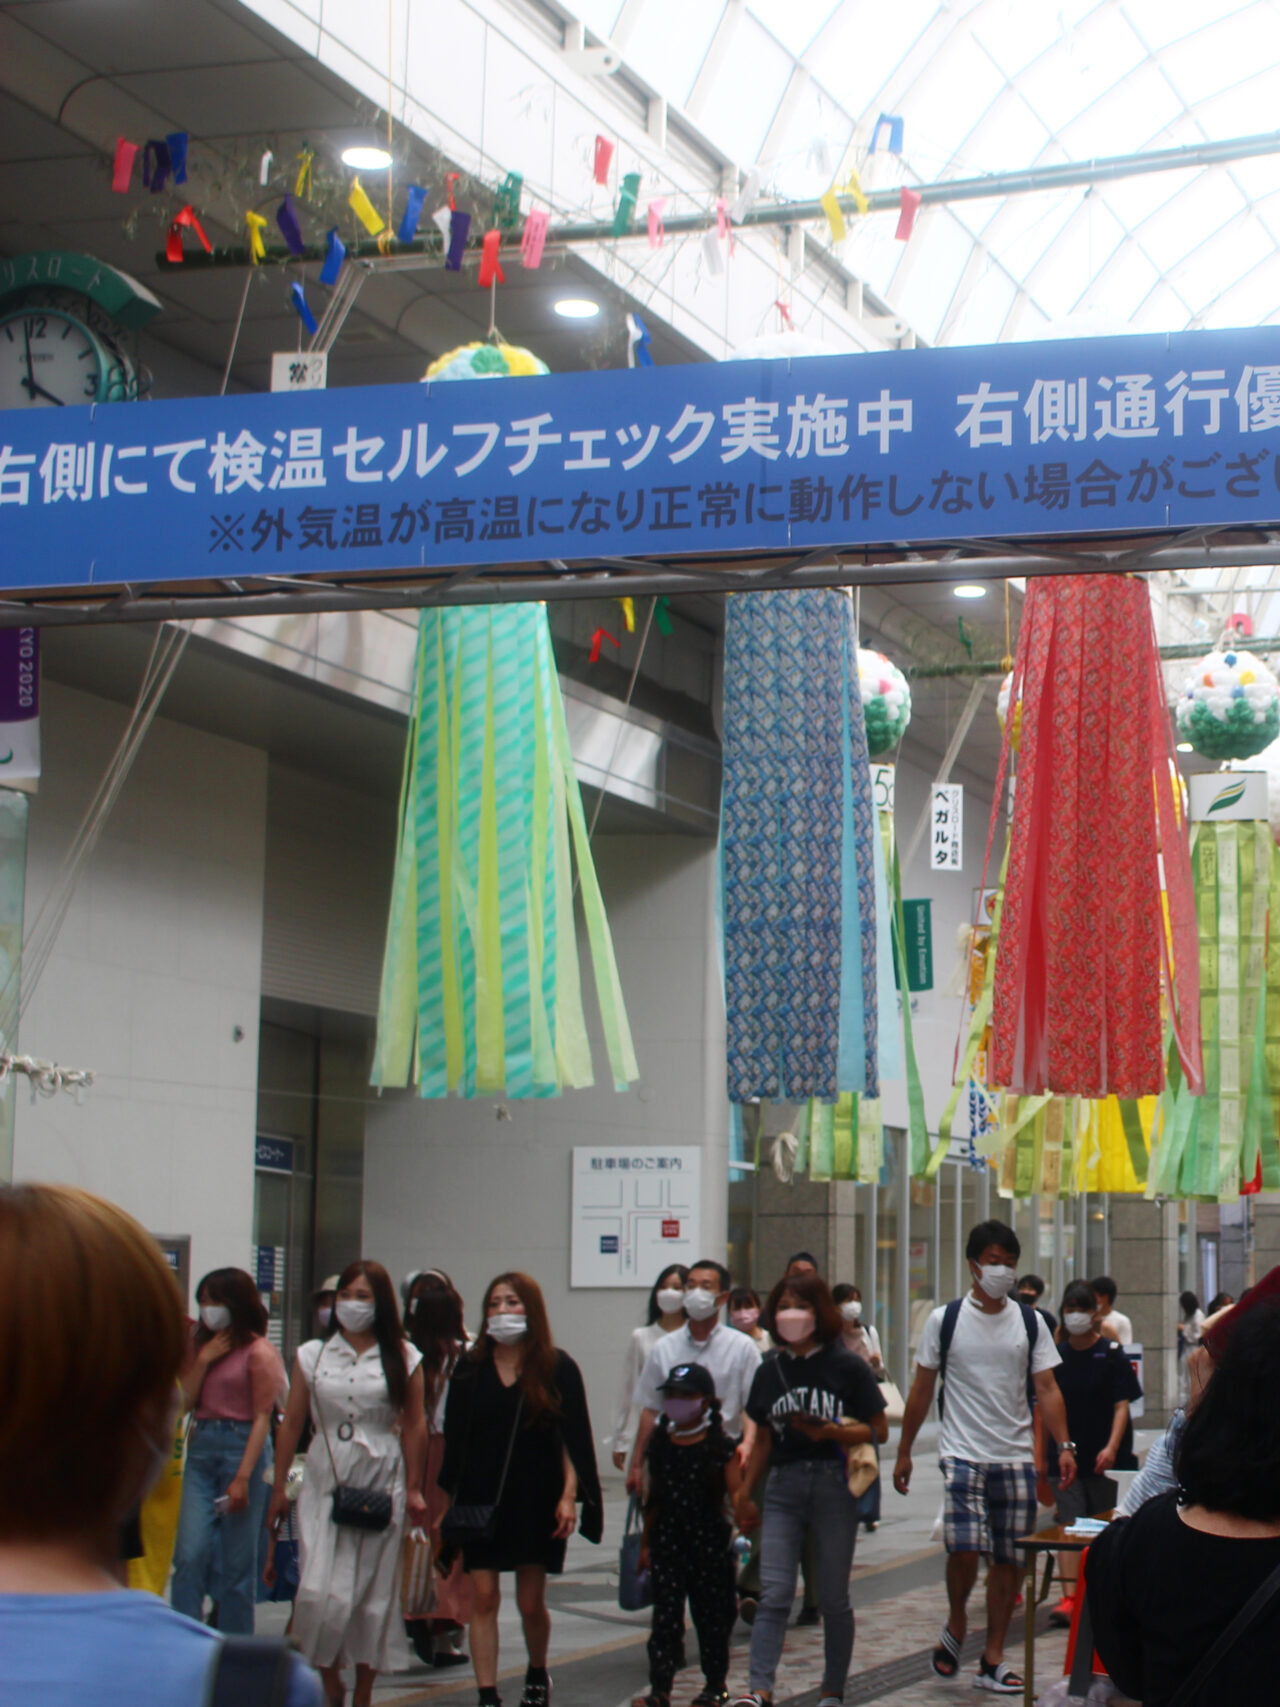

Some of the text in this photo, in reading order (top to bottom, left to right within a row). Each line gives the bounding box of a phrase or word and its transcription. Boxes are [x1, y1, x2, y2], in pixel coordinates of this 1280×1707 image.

[84, 373, 99, 396] 3
[0, 389, 913, 507] 右側にて検温セルフチェック実施中
[18, 661, 34, 708] 2020
[590, 1157, 682, 1171] 駐車場のご案内
